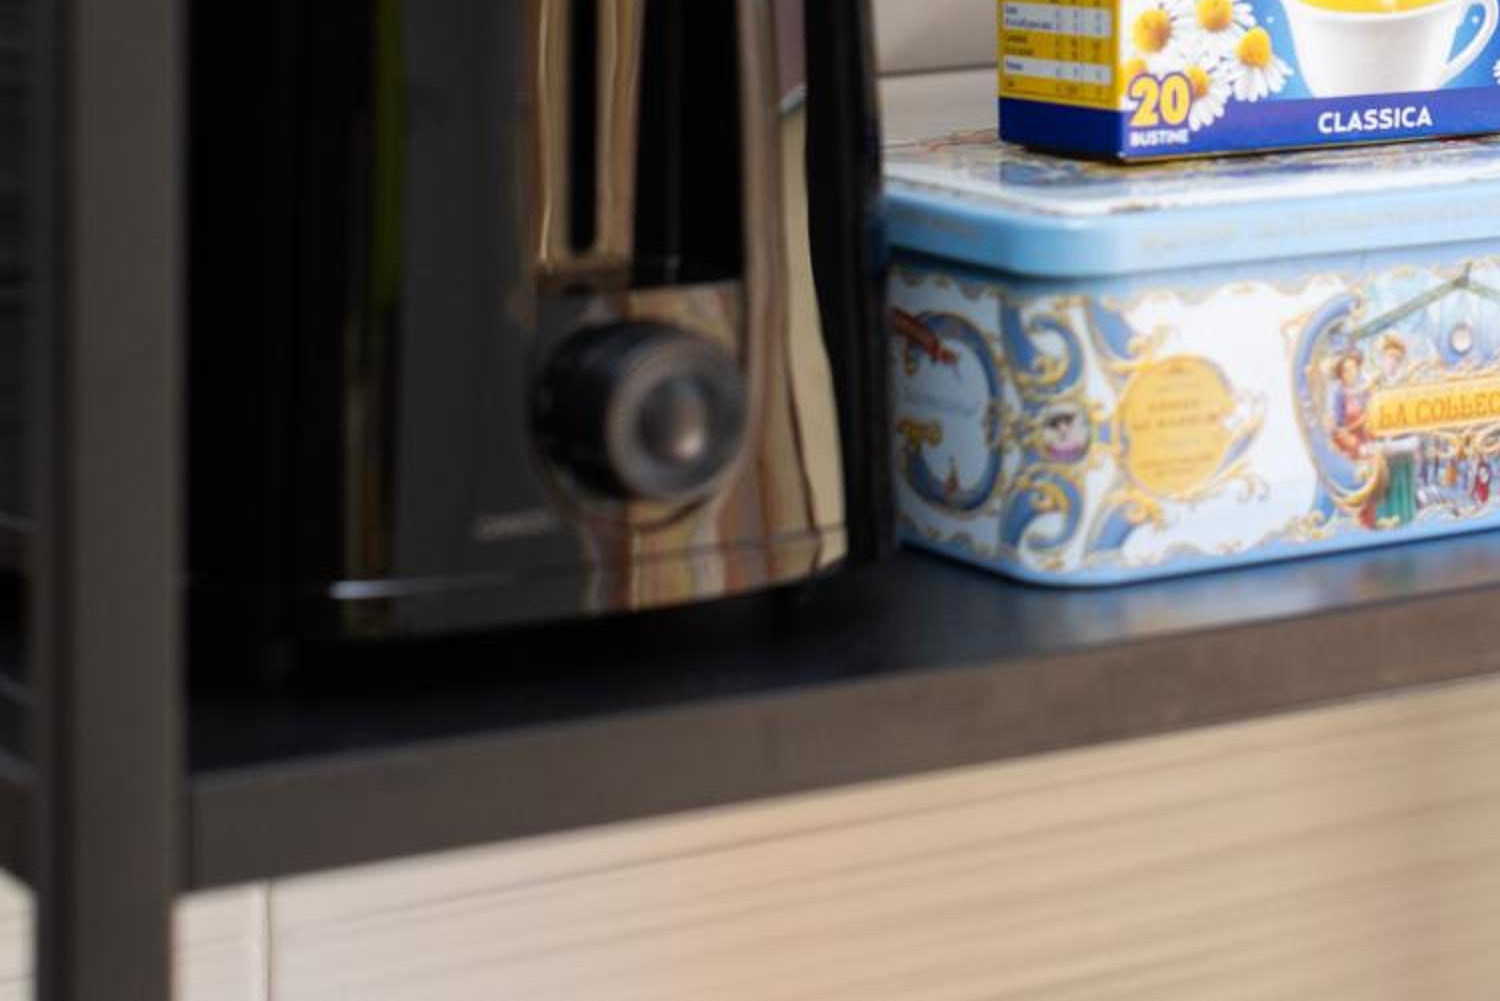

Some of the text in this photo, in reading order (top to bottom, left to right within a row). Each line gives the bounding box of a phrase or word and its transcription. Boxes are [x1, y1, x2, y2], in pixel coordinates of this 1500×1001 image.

[1128, 72, 1191, 129] 20
[1317, 105, 1434, 134] CLASSICA
[1129, 129, 1189, 148] BUSTINE
[1379, 402, 1408, 428] LA
